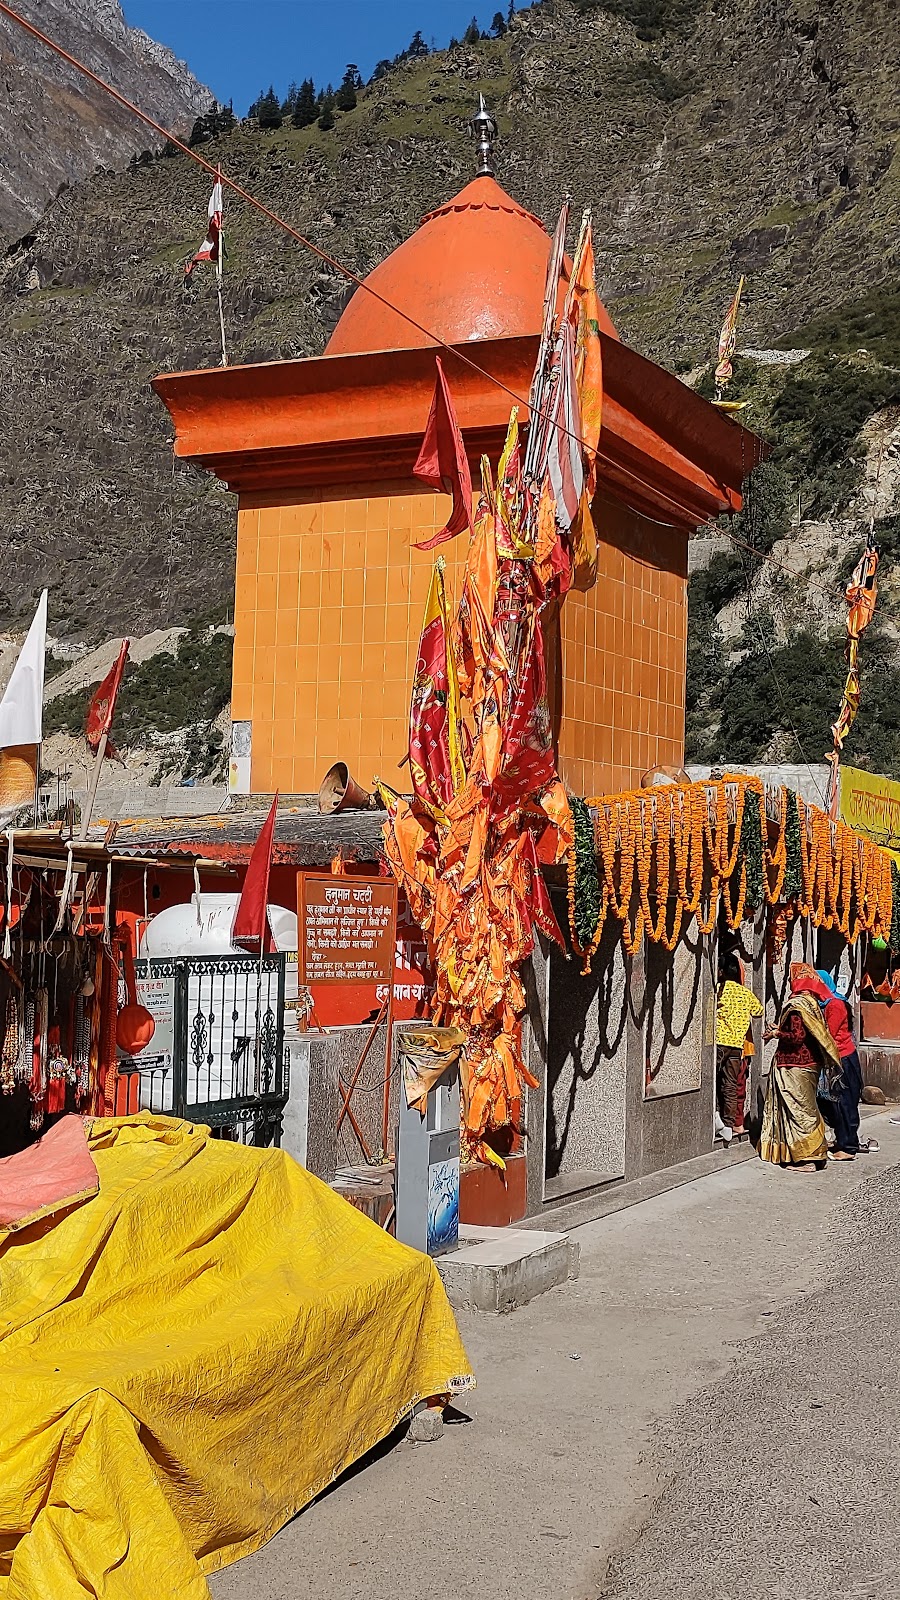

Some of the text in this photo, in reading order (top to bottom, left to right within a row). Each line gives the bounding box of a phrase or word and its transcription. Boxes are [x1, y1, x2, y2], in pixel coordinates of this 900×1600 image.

[324, 885, 373, 905] हनुमान चट्टी
[376, 984, 410, 1004] हनमान
